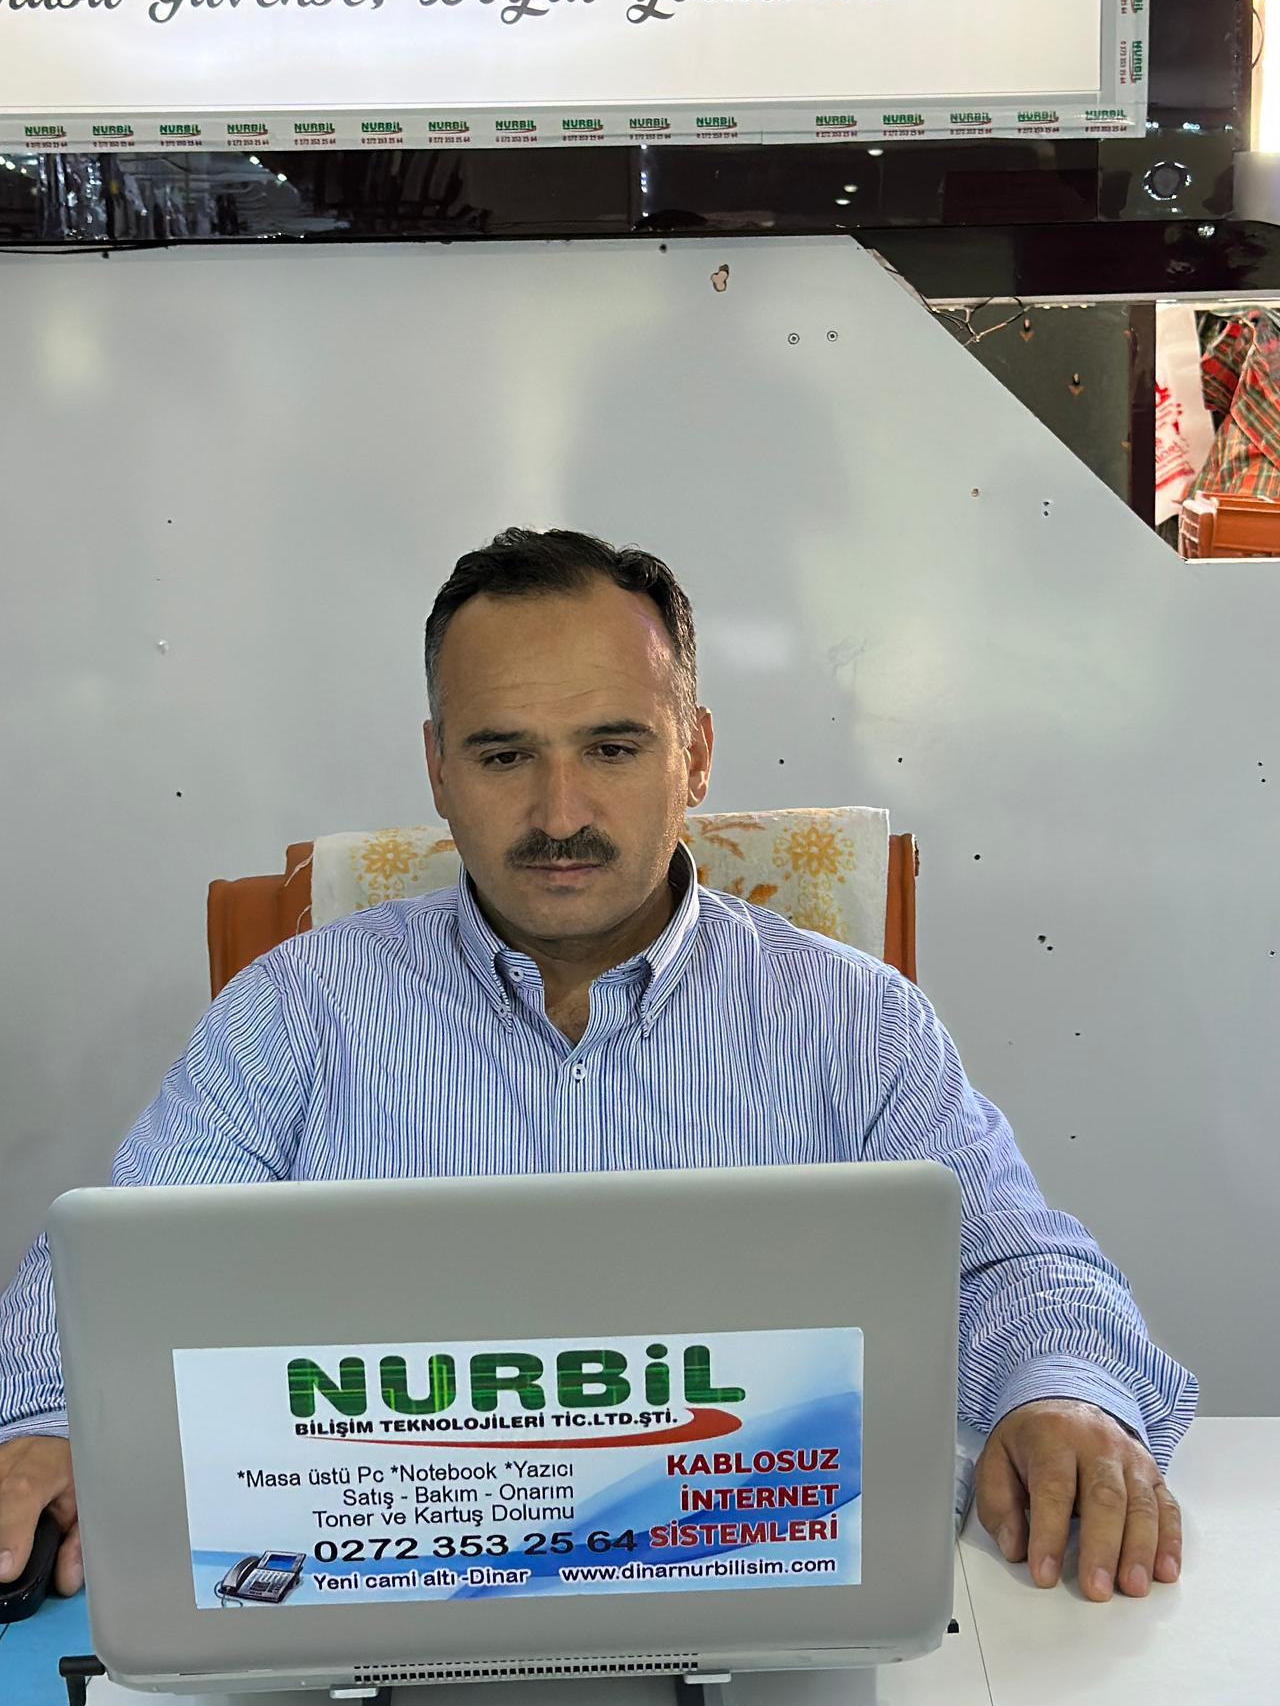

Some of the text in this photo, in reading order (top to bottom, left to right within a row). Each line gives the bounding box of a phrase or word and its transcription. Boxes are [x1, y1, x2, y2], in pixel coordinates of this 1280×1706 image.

[295, 1419, 374, 1439] BİLİŞİM
[380, 1410, 545, 1433] TEKNOLOJİLERİ
[308, 1467, 351, 1485] üstü
[357, 1466, 384, 1484] Pc
[667, 1449, 839, 1476] KABLOSUZ
[343, 1489, 394, 1510] Satış
[415, 1486, 478, 1504] Bakım
[499, 1483, 574, 1501] Onarım
[681, 1484, 839, 1512] İNTERNET
[313, 1503, 575, 1528] Toner ve Kartuş Dolumu
[650, 1513, 838, 1548] SİSTEMLERİ
[314, 1529, 638, 1563] 0272 353 25 64
[314, 1573, 359, 1591] Yeni
[365, 1570, 417, 1589] cami
[423, 1567, 456, 1587] altı
[561, 1558, 836, 1582] www.dinarnurbilisim.com
